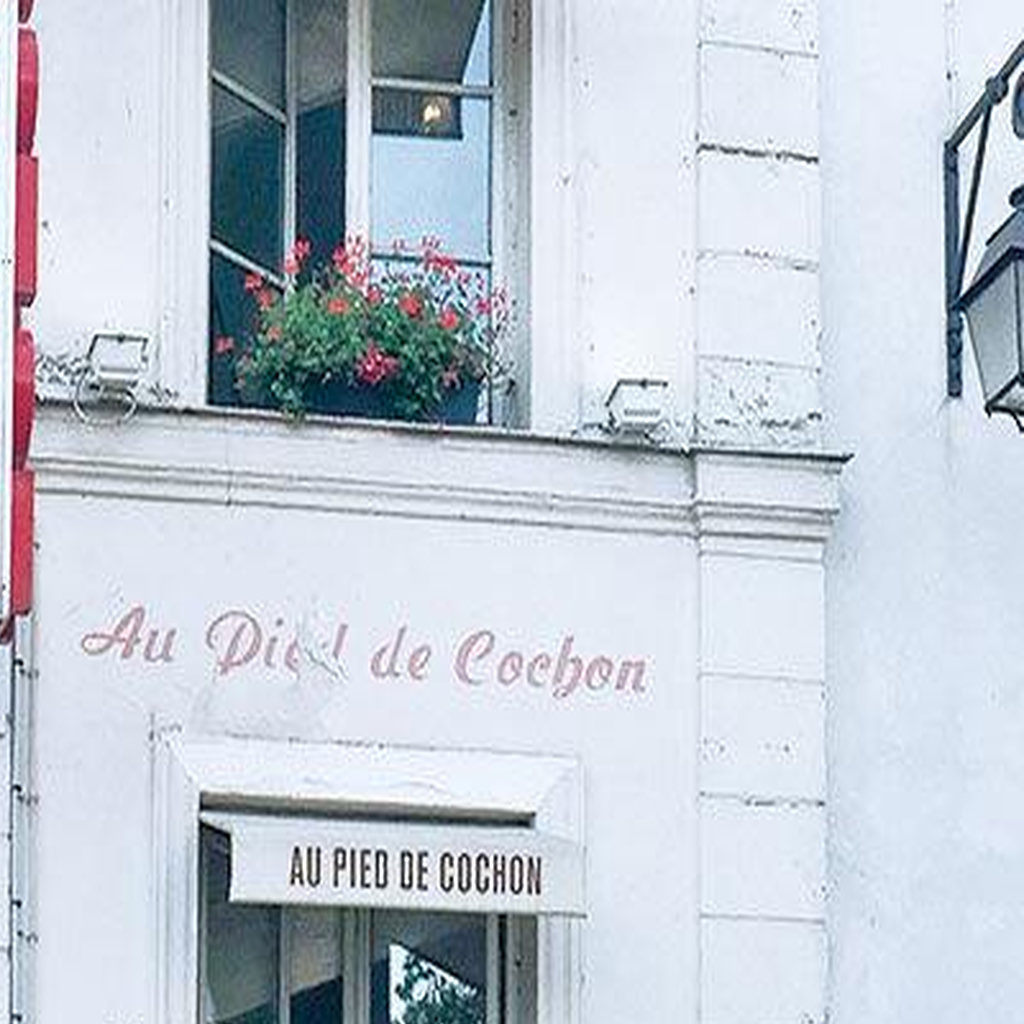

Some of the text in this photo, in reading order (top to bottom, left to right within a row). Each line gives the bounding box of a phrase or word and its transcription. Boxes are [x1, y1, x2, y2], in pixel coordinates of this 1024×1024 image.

[81, 606, 177, 662] Au
[370, 625, 432, 680] de
[454, 630, 645, 697] Cochon
[290, 846, 542, 896] AU PIED DE COCHON
